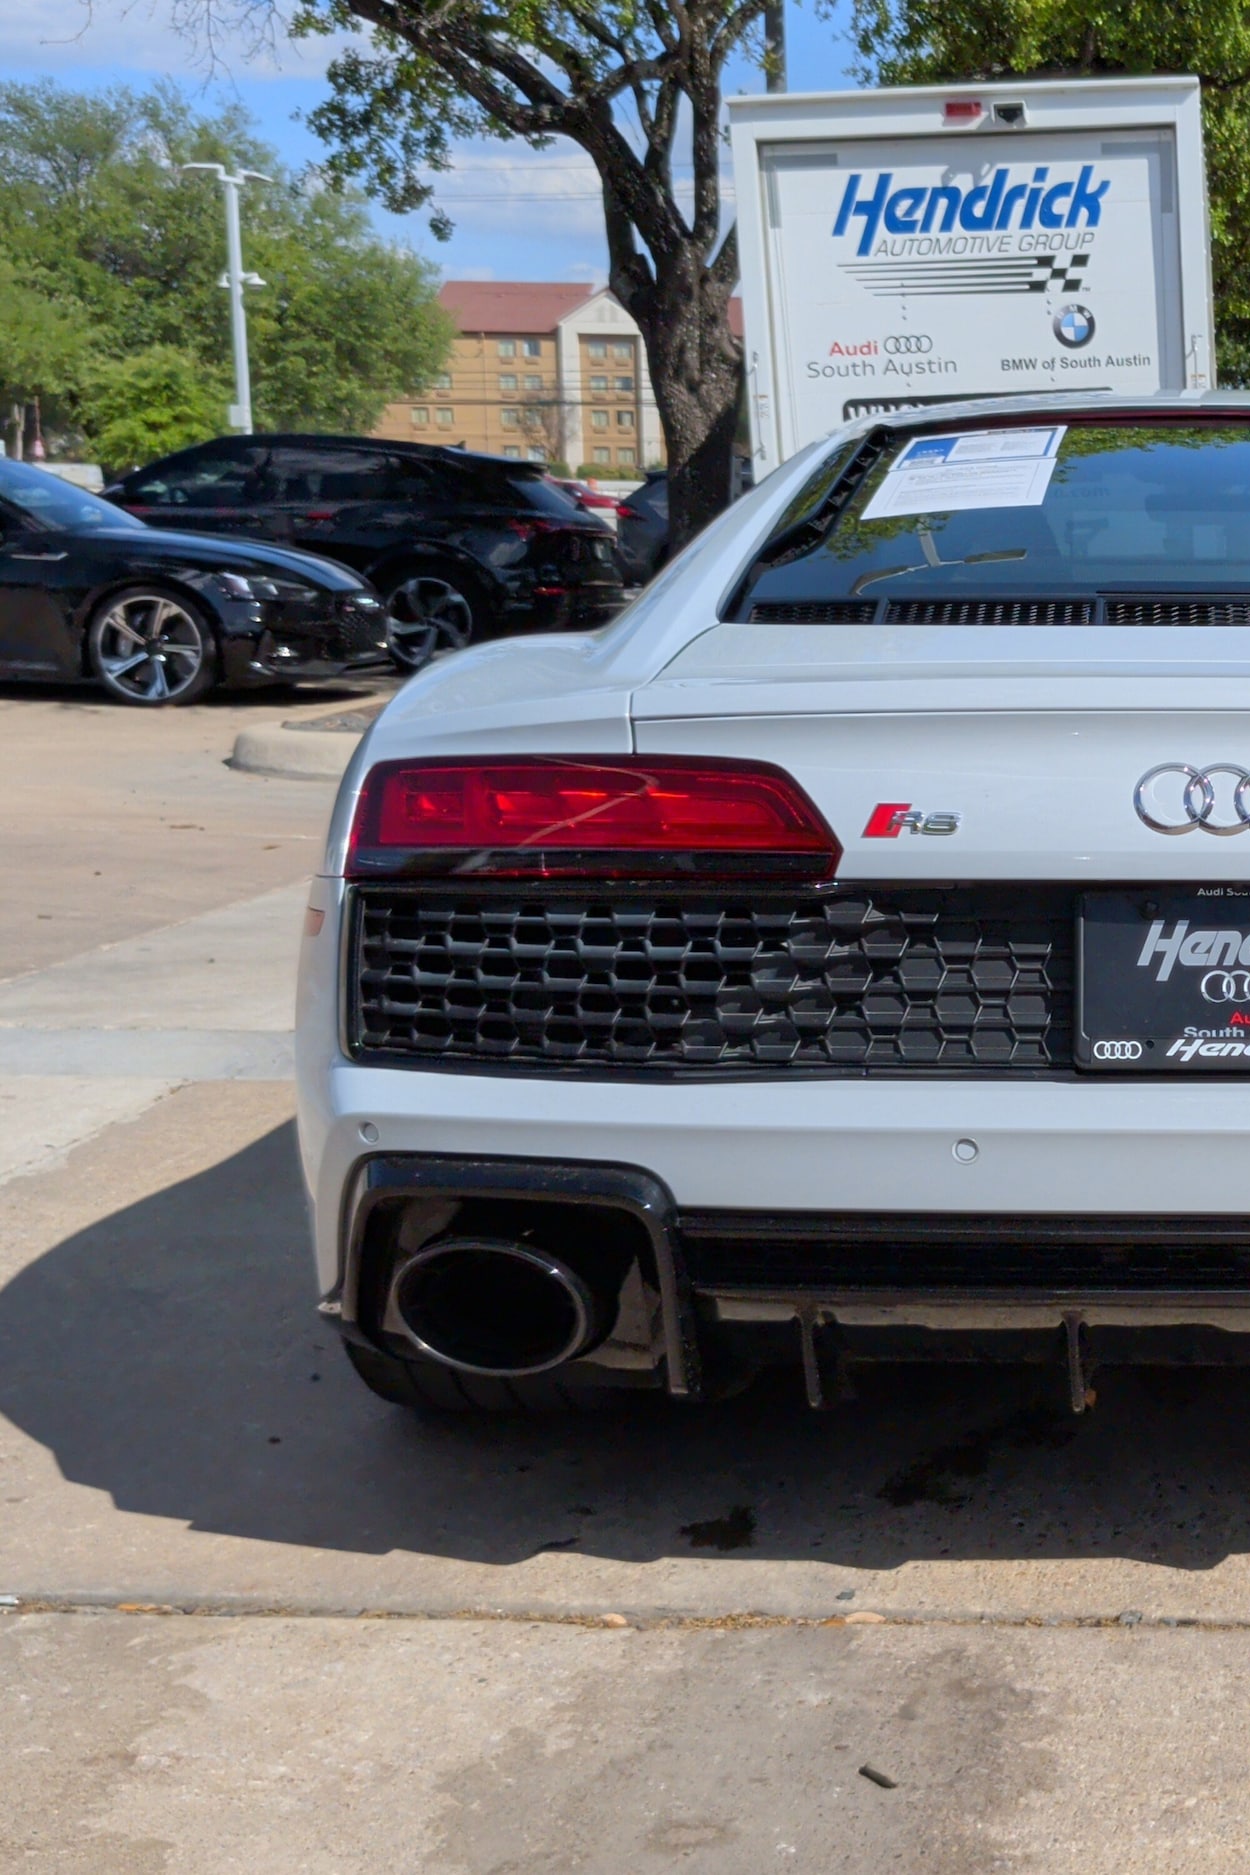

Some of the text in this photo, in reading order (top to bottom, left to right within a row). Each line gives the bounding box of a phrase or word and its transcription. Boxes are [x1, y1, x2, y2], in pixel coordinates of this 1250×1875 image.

[832, 165, 1111, 256] Hendrick
[873, 232, 1096, 257] AUTOMOTIVE GROUP
[829, 340, 878, 356] Audi
[807, 356, 958, 378] South Austin
[1001, 353, 1151, 371] BMW of South Austin
[1197, 887, 1224, 896] Audi
[1183, 1026, 1245, 1038] South
